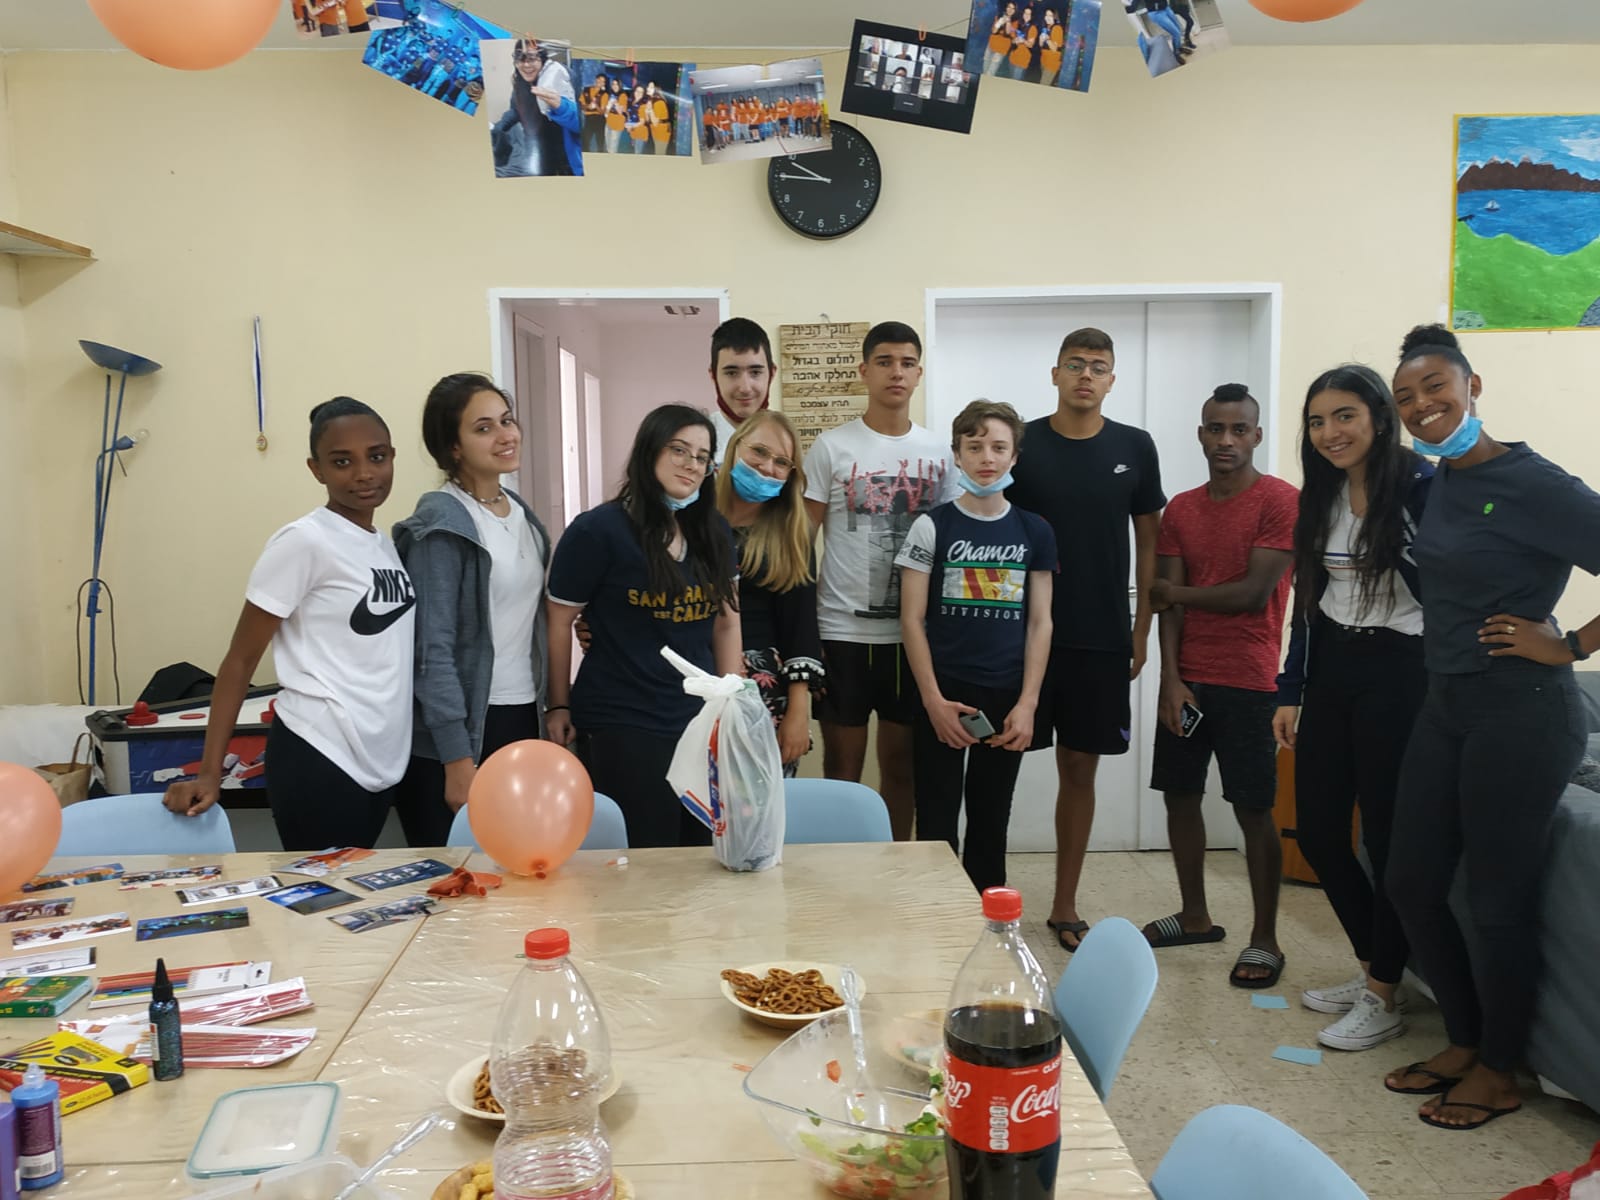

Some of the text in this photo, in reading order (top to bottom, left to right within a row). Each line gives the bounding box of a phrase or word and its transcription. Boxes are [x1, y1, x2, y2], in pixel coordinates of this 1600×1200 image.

[858, 157, 865, 166] 2
[864, 180, 870, 188] 3
[784, 194, 790, 202] 8
[798, 210, 804, 219] 7
[839, 214, 846, 223] 5
[818, 219, 824, 227] 6
[791, 324, 821, 336] הבית
[826, 353, 856, 365] לחלום
[792, 368, 857, 383] תחלקו אהבה
[947, 540, 1028, 567] Champs
[370, 567, 415, 603] NIKE
[627, 588, 667, 608] SAN
[941, 605, 1022, 620] DIVISION
